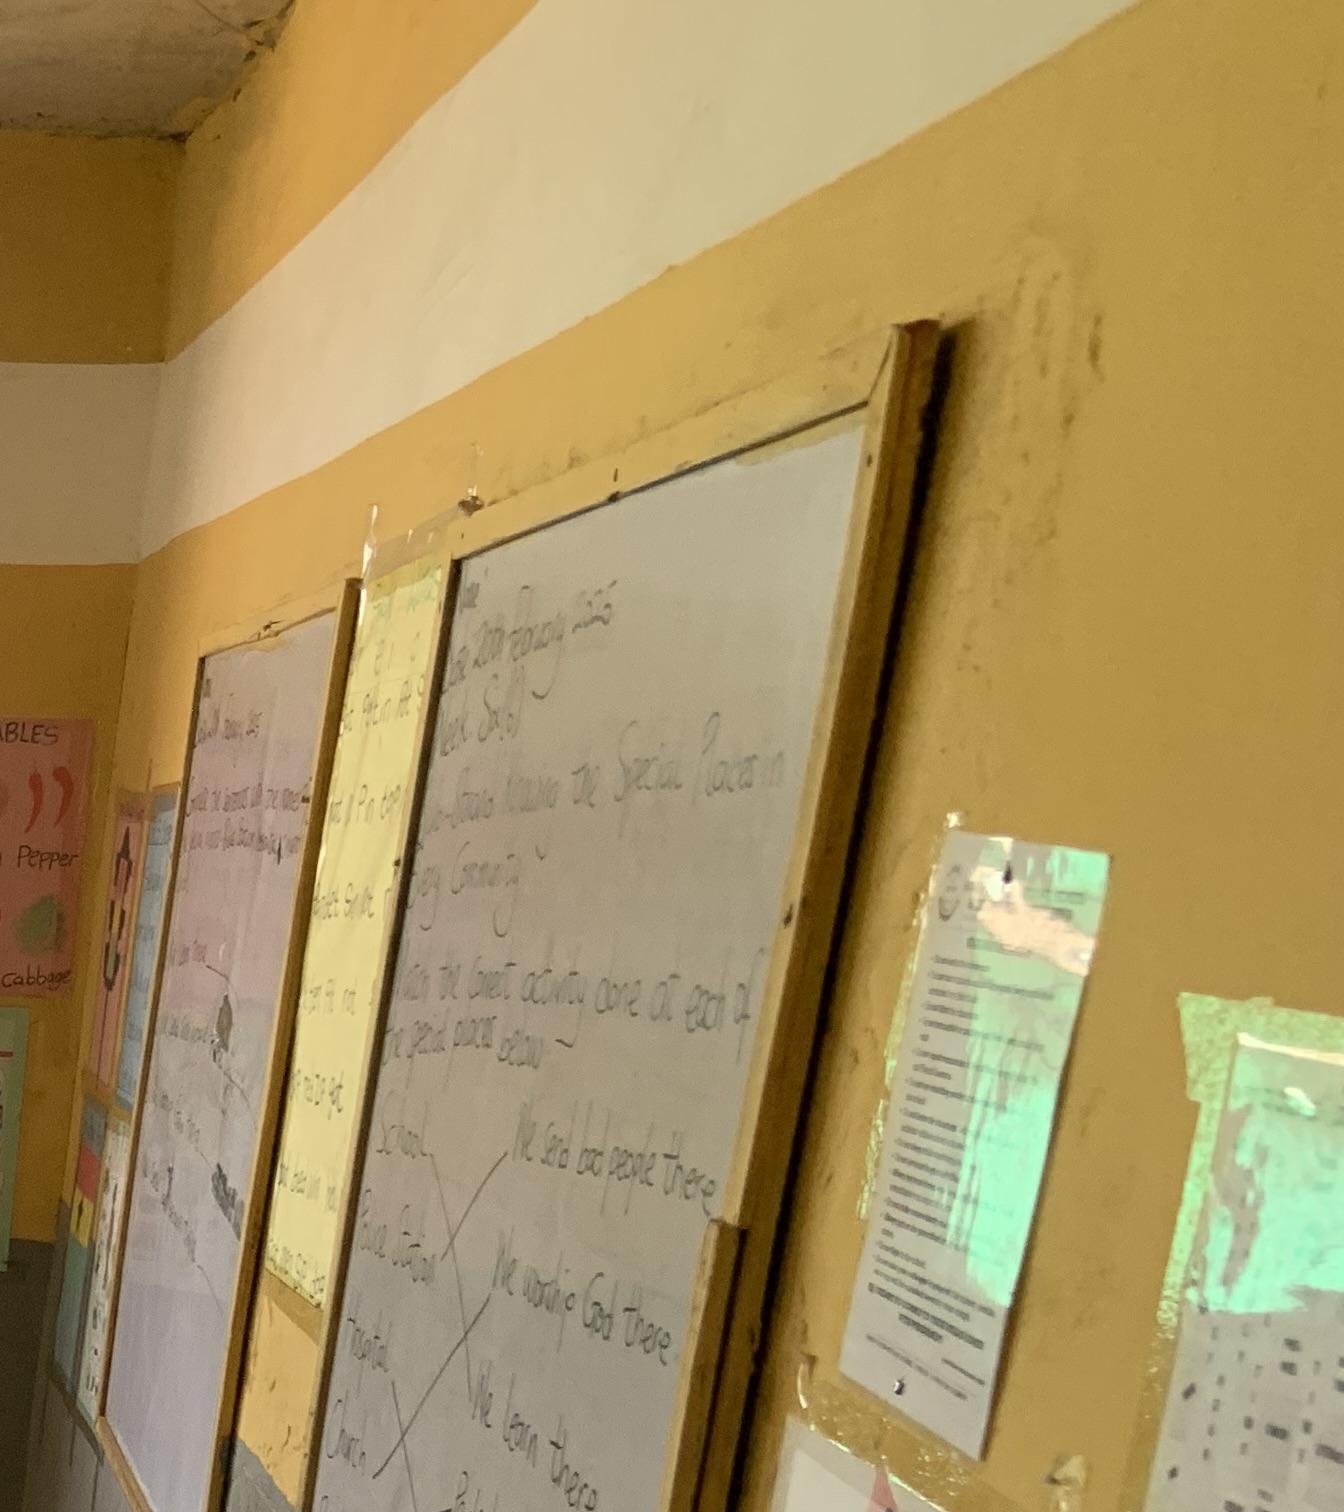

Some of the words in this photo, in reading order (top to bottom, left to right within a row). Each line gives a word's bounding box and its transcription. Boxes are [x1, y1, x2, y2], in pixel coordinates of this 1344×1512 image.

[17, 846, 79, 871] Pepper
[2, 966, 72, 990] Cabbage
[595, 947, 642, 1017] done
[684, 948, 727, 1034] each
[601, 1130, 657, 1216] people
[582, 1272, 618, 1342] God
[623, 1287, 672, 1367] there
